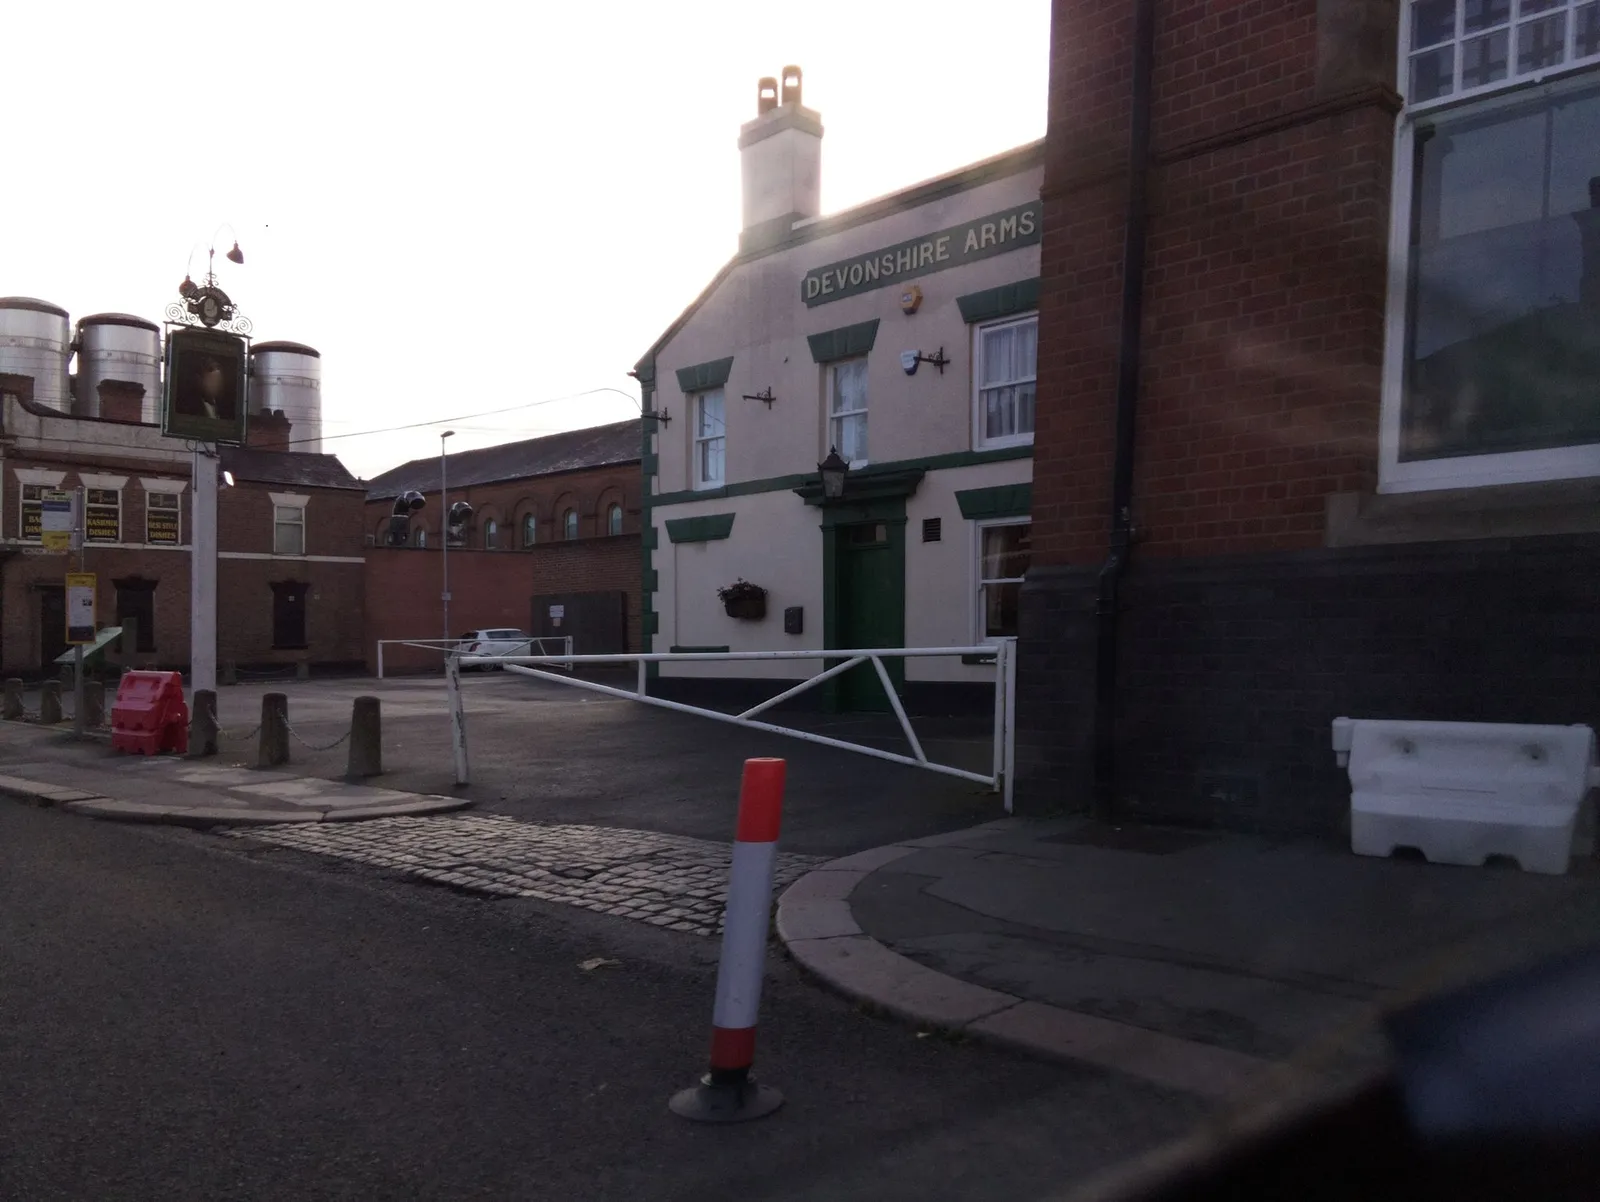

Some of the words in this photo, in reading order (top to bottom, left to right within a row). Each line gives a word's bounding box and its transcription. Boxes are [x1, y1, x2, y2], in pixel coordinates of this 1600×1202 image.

[806, 235, 951, 300] DEVONSHIRE
[963, 210, 1036, 254] ARMS
[88, 528, 117, 536] DISHES
[149, 530, 176, 539] DISHES
